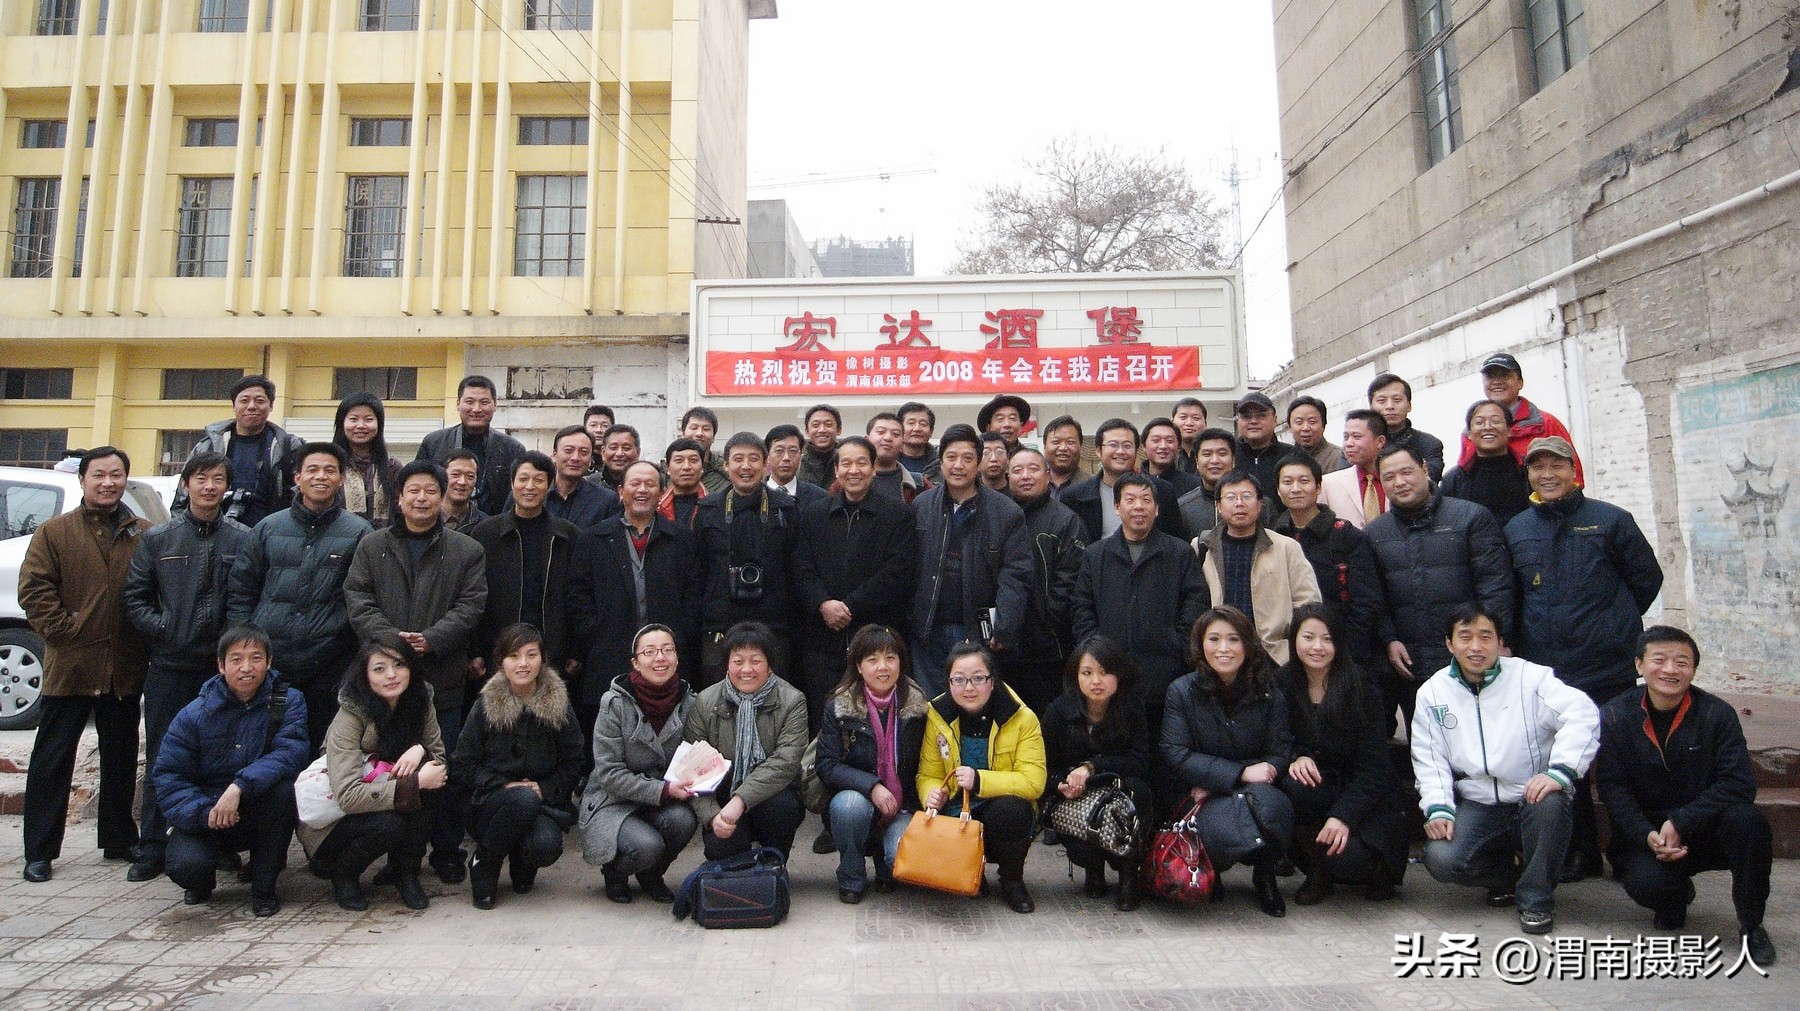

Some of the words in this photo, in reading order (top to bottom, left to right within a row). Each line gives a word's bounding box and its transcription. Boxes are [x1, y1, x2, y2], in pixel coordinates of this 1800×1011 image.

[775, 306, 1151, 350] 宏达酒堡
[734, 358, 838, 386] 热烈祝贺
[846, 356, 909, 370] 橡树摄影
[846, 374, 911, 388] 渭南俱乐部
